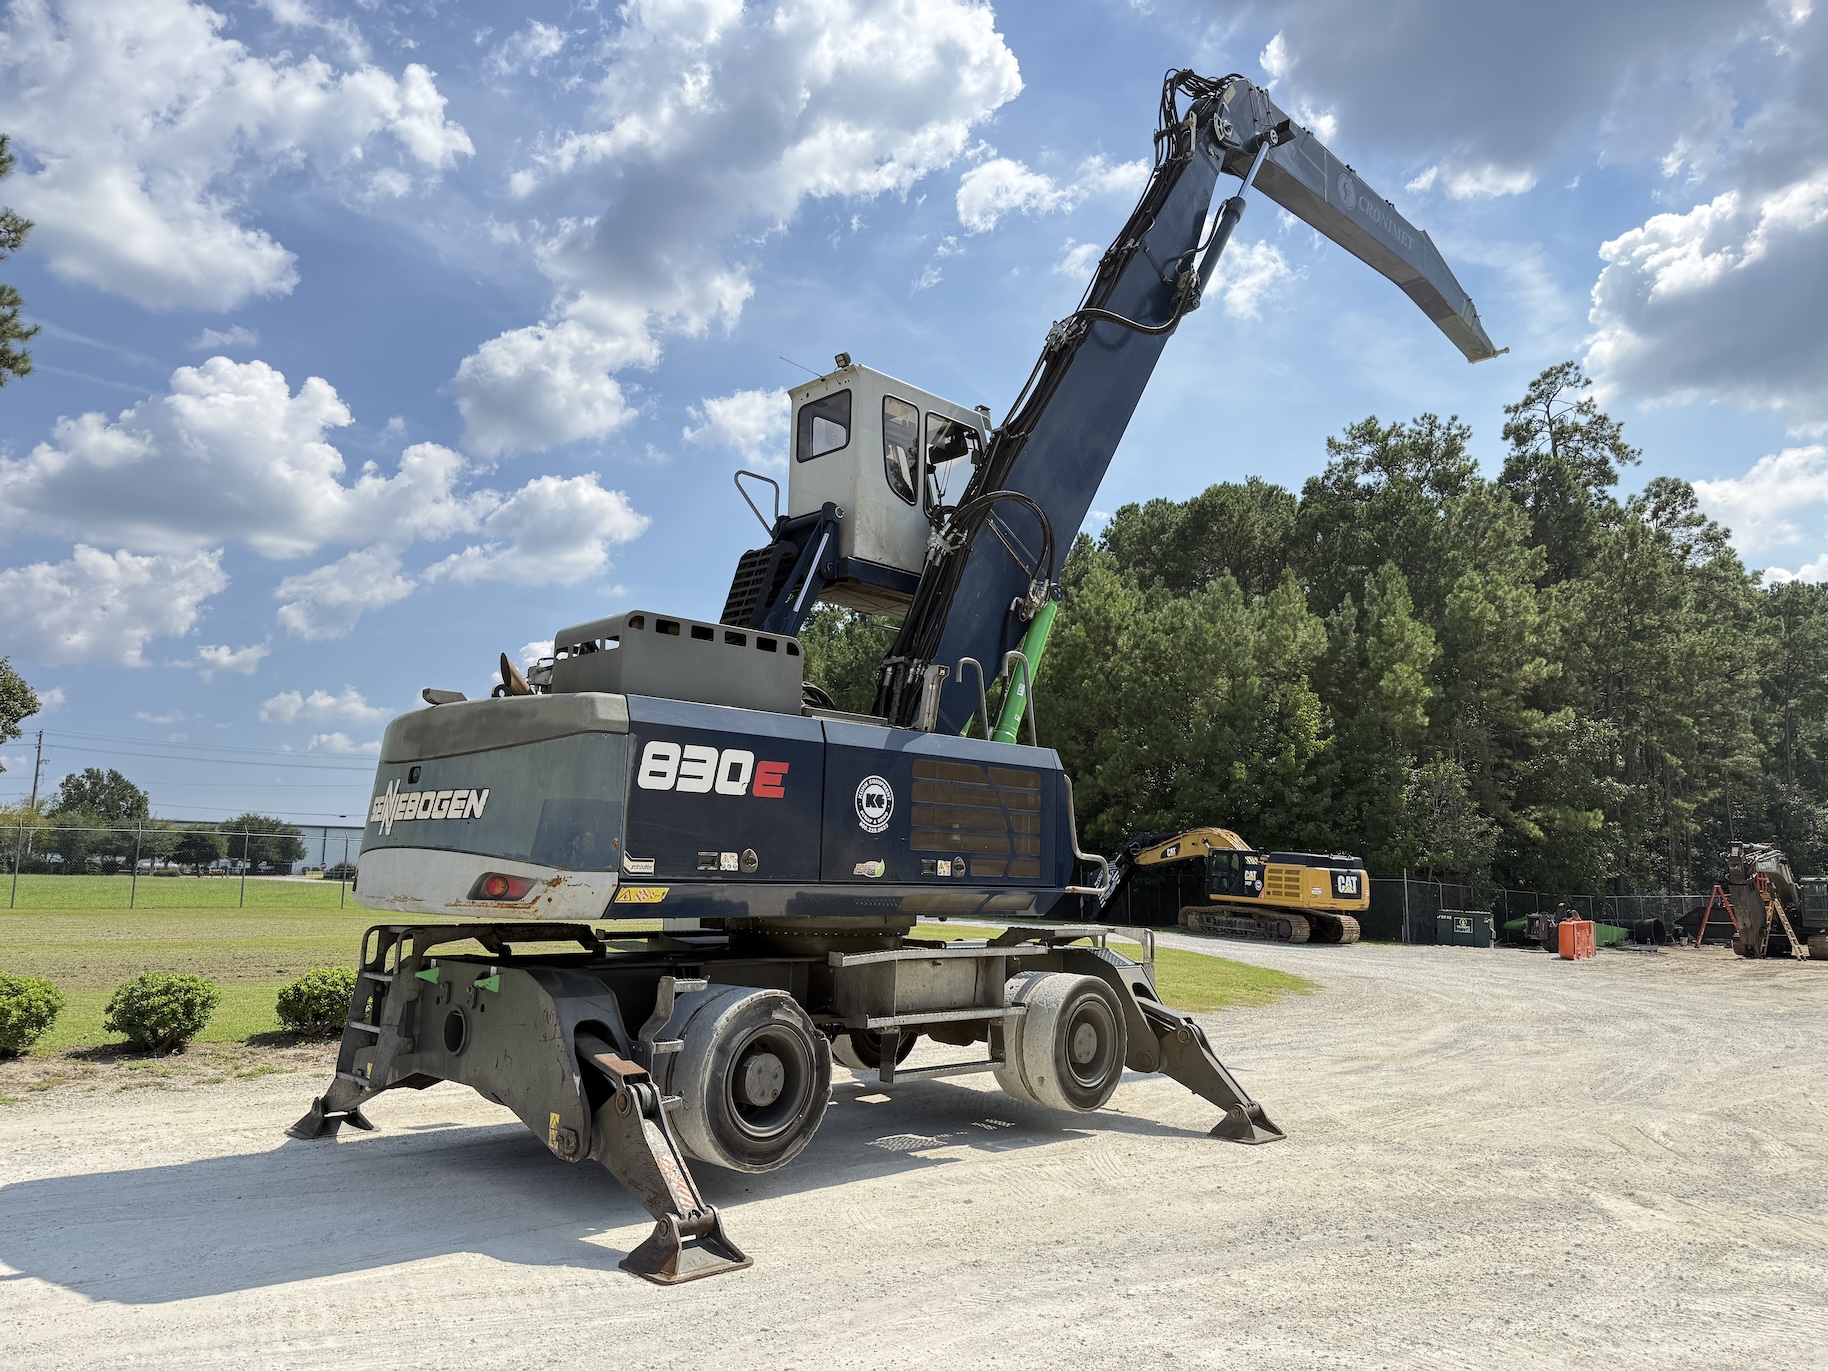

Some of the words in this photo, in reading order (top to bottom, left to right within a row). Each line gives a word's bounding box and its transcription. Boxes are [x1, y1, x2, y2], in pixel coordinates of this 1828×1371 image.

[1359, 196, 1415, 251] CRONIMET
[868, 778, 892, 801] EQUIPMENT
[1166, 847, 1177, 857] CAT
[1244, 870, 1257, 881] CAT
[1337, 875, 1358, 894] CAT
